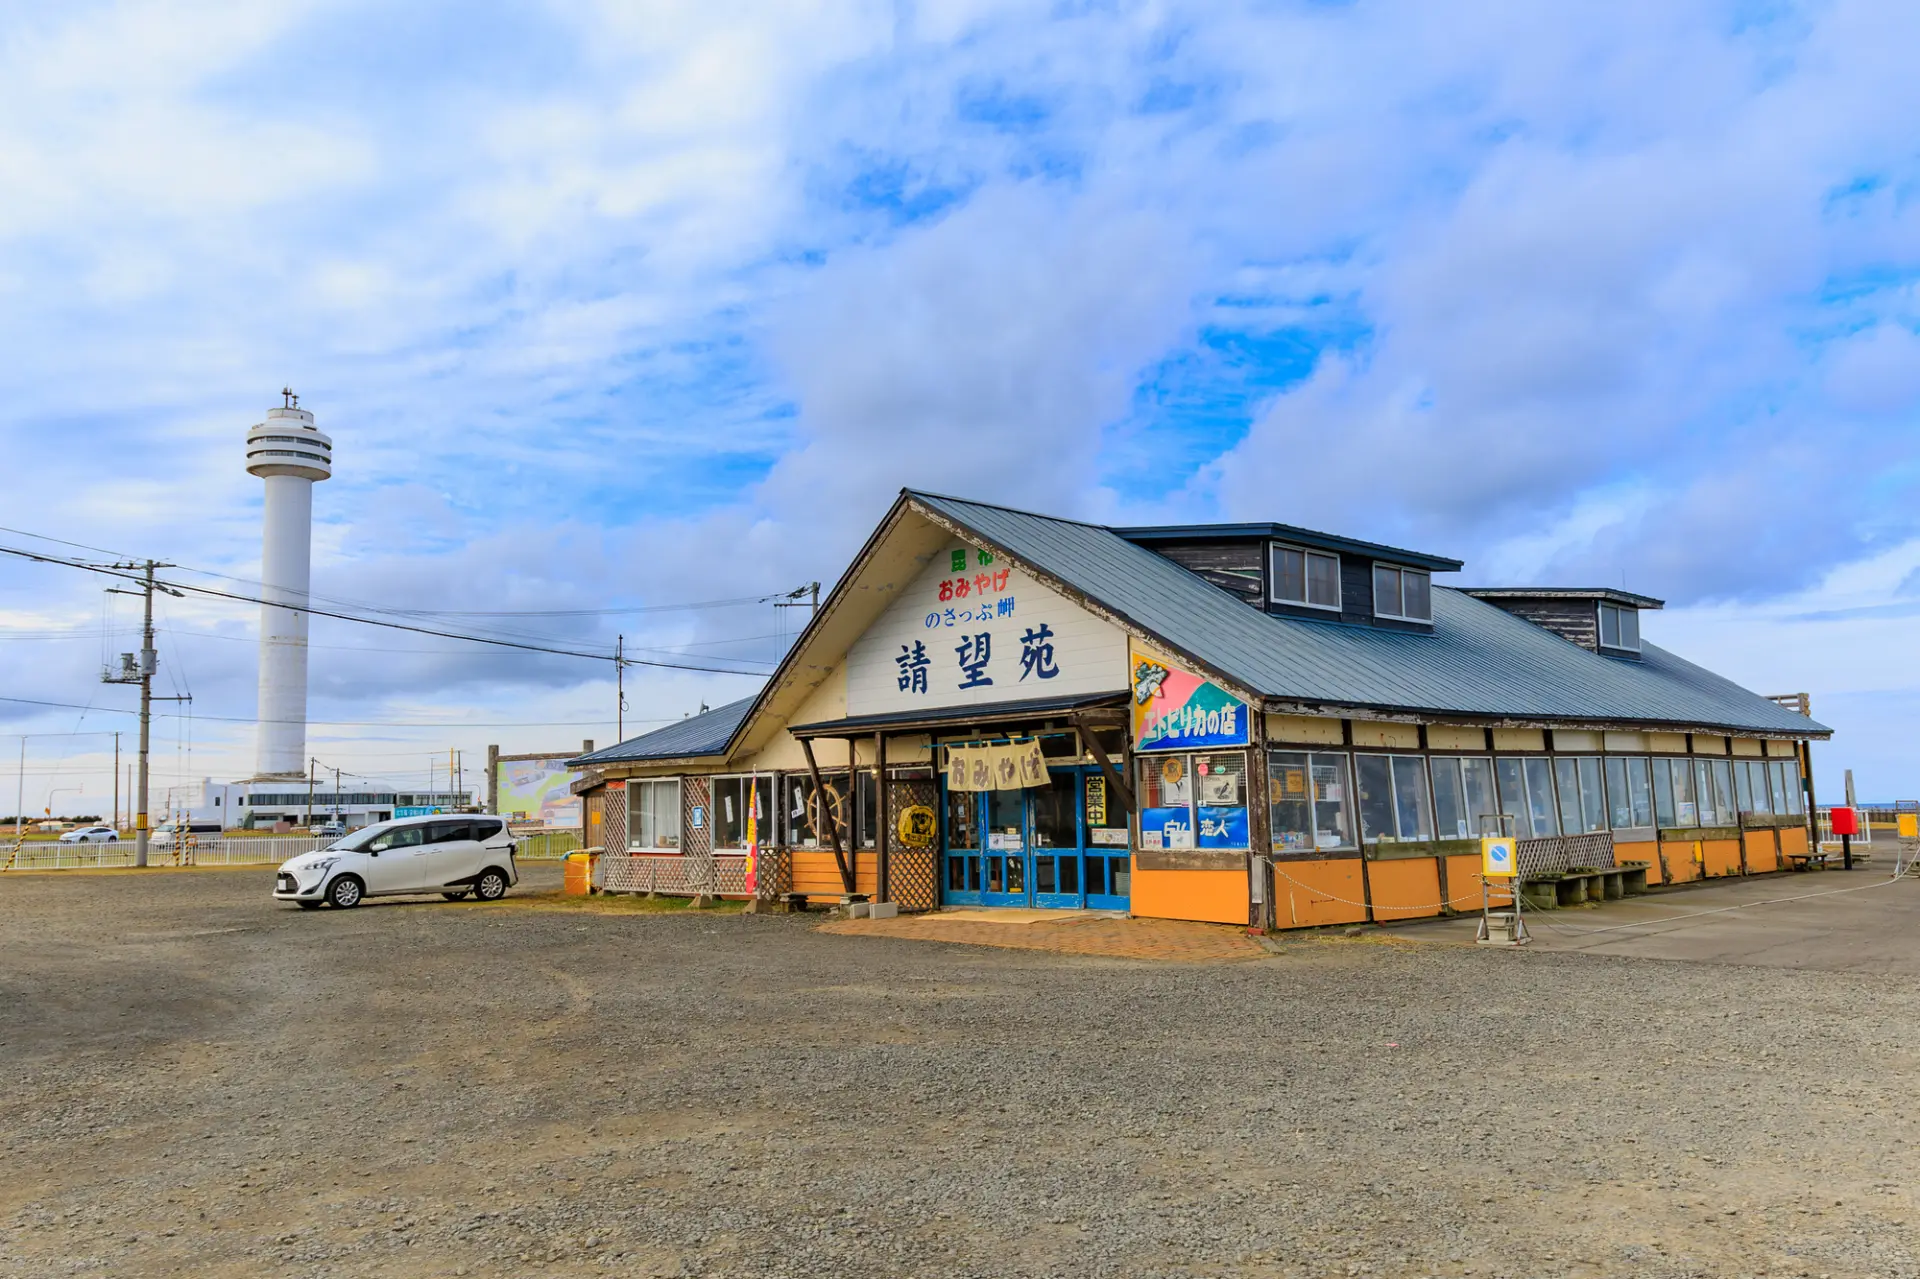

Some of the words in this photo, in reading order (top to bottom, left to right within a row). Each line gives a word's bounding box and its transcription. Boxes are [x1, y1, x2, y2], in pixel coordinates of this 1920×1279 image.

[938, 568, 1011, 602] おみやげ
[925, 597, 1015, 629] のさっぷ岬
[895, 623, 1060, 694] 請望苑
[1144, 702, 1237, 741] エトピリカの店
[952, 747, 1041, 788] おみやげ
[1087, 777, 1104, 824] 営業中
